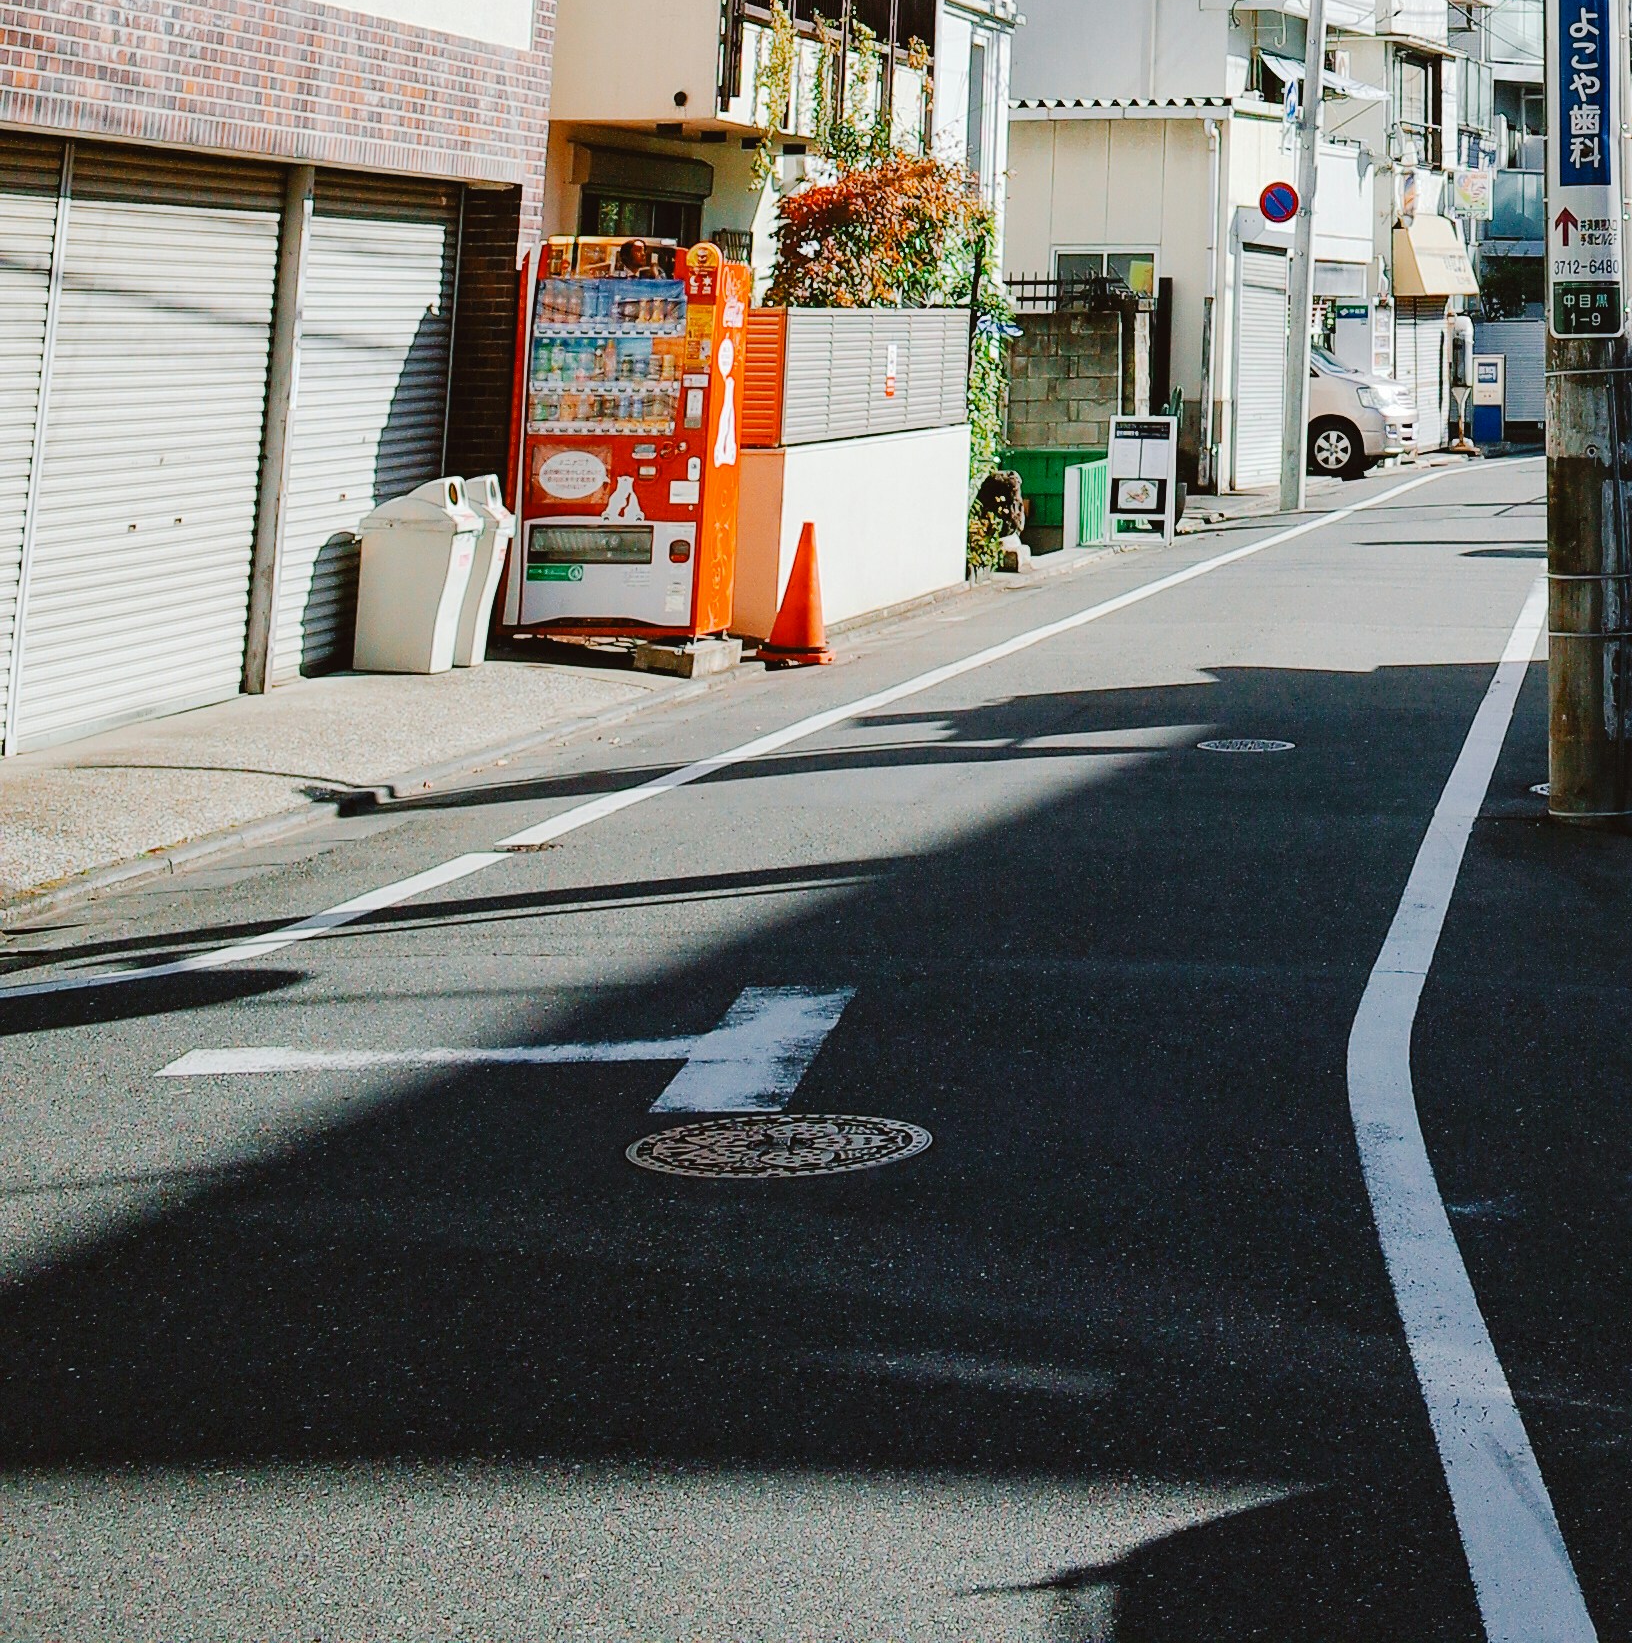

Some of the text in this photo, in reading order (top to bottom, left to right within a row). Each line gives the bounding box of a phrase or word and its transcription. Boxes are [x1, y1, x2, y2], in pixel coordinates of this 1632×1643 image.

[1569, 7, 1601, 169] よこや歯科
[1554, 259, 1619, 275] 3712-6480
[1563, 293, 1608, 308] 中目黒
